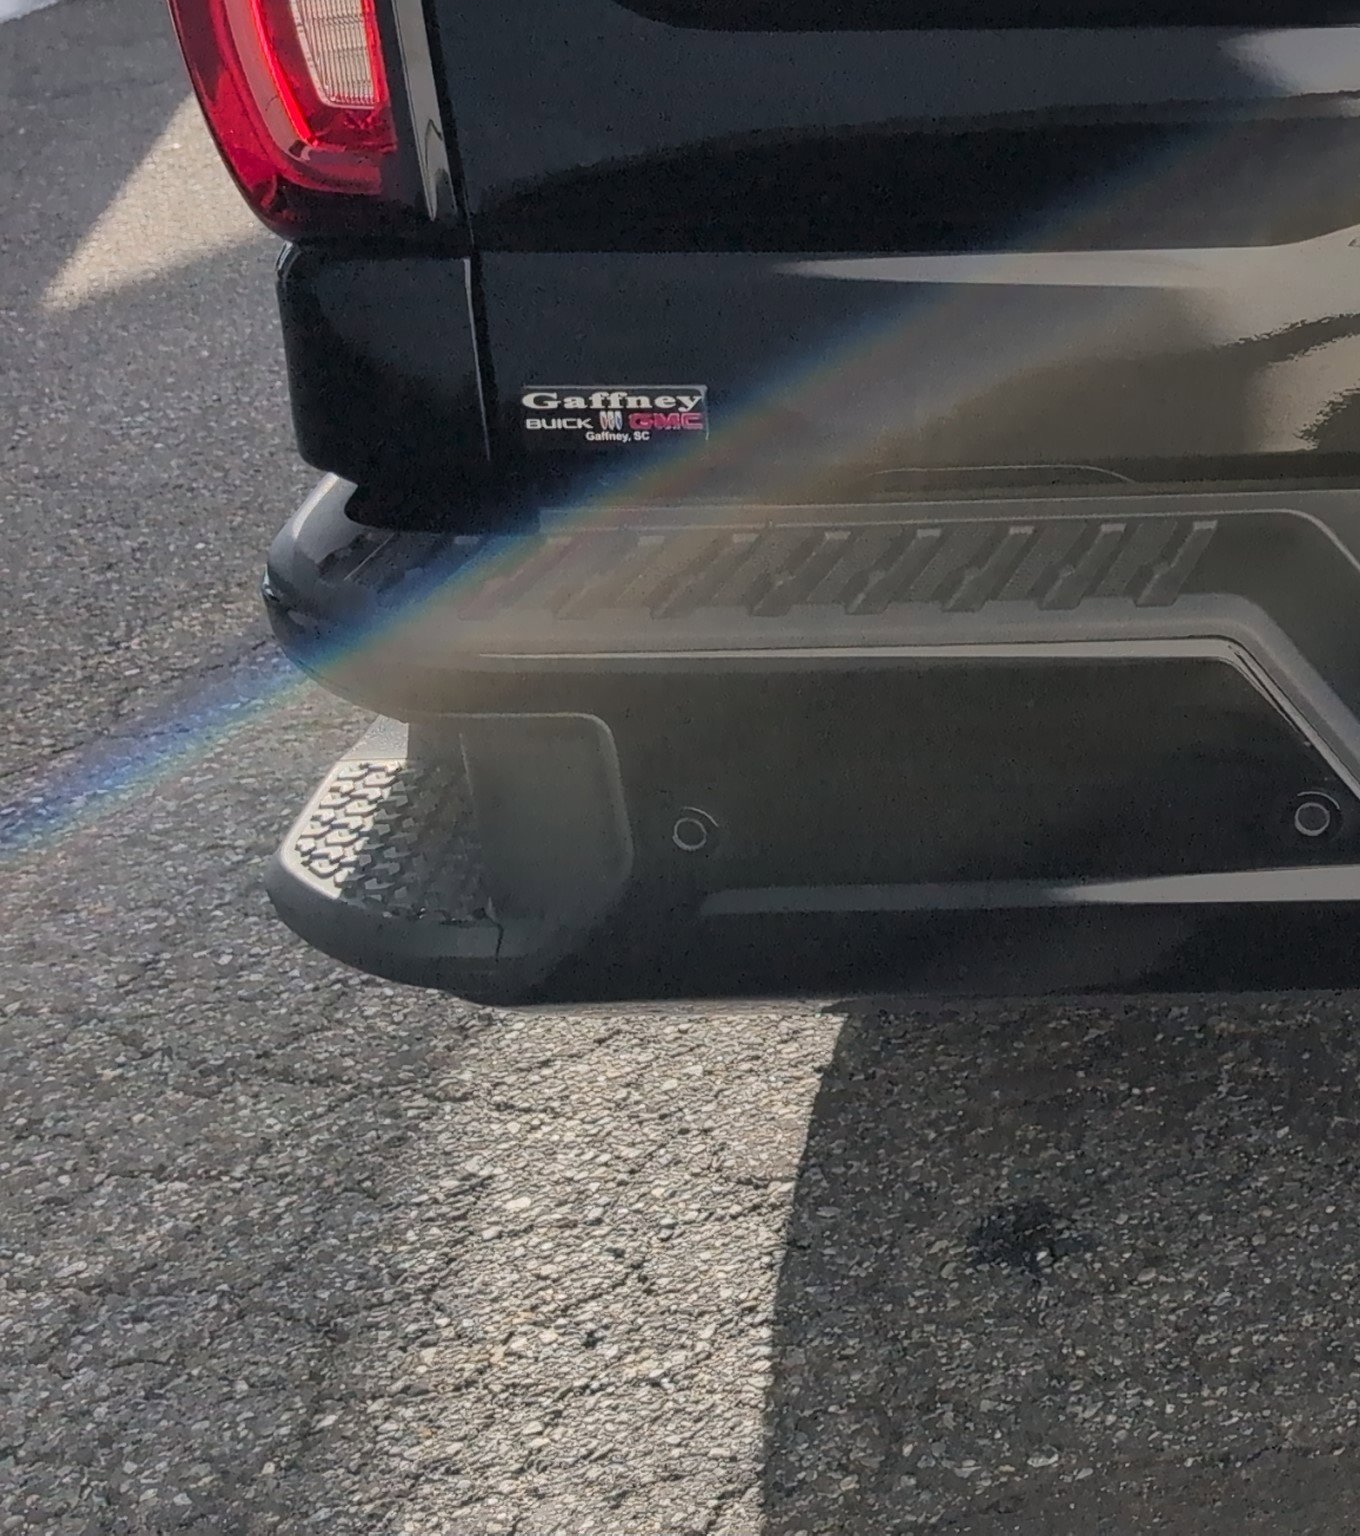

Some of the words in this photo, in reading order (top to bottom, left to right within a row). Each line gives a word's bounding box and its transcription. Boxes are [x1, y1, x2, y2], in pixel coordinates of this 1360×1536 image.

[521, 391, 704, 412] Gaffney
[525, 417, 594, 430] BUICK
[629, 412, 705, 431] GMC
[585, 431, 632, 443] Gaffney,
[633, 431, 651, 441] SC
